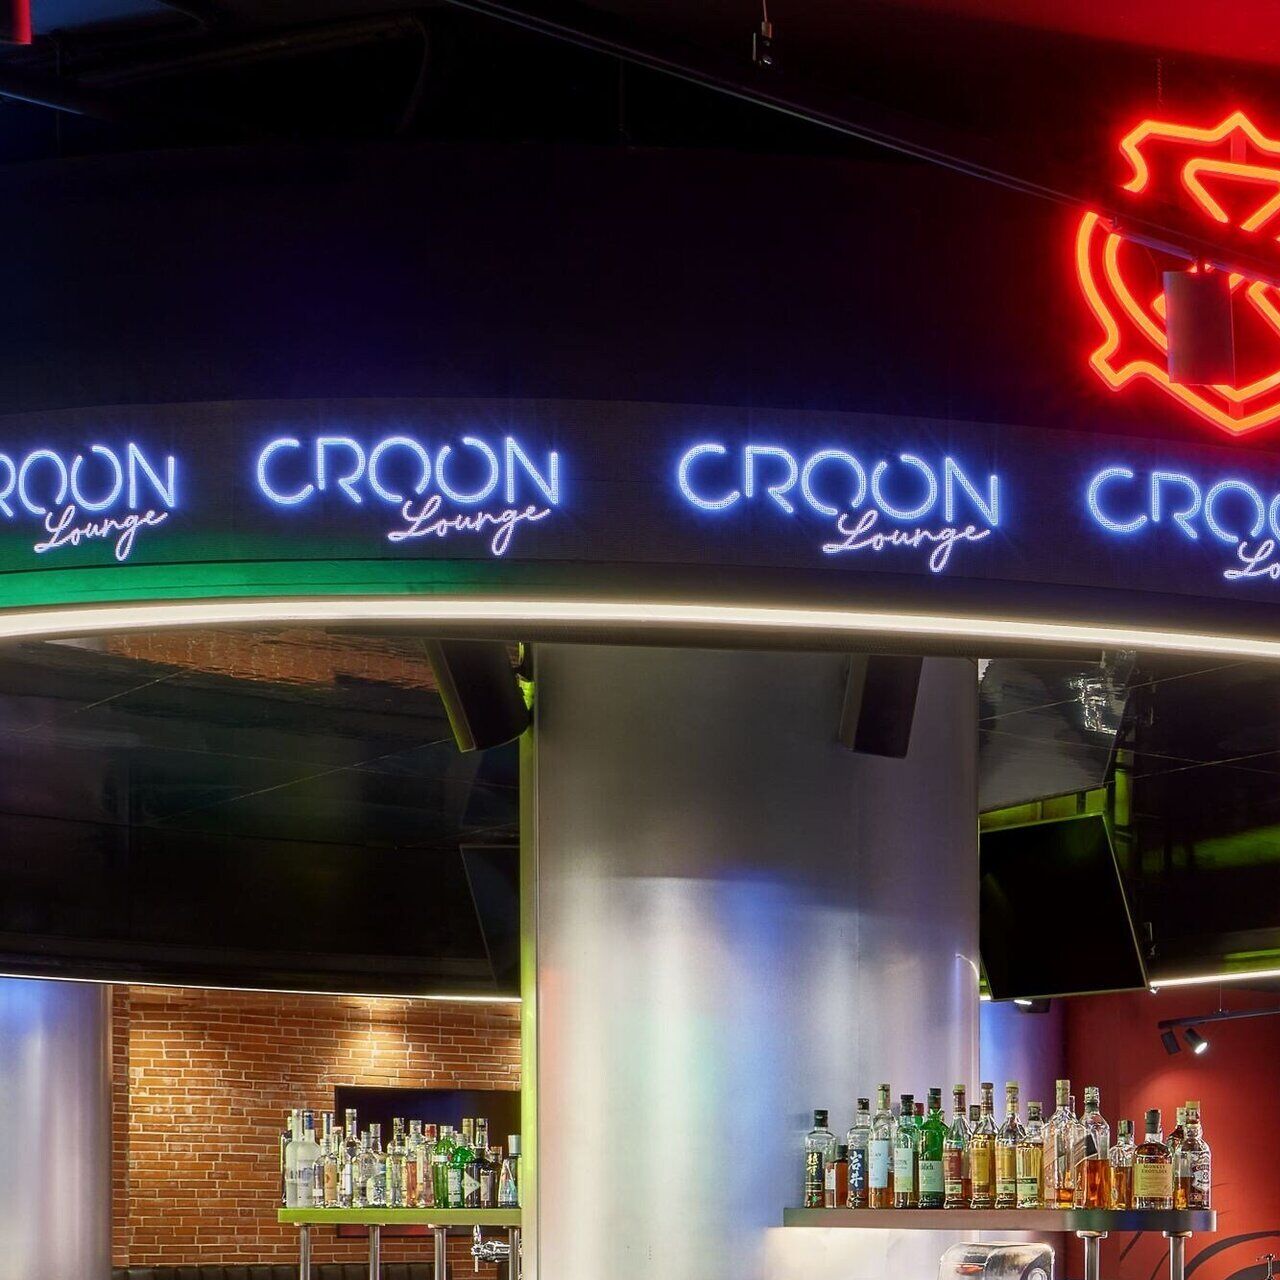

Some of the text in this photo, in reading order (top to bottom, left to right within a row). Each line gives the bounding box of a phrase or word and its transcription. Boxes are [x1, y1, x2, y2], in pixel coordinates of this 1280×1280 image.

[255, 435, 562, 507] CROON
[676, 442, 1001, 527] CROON
[33, 505, 169, 562] Lounge
[387, 494, 552, 556] Lounge
[822, 509, 991, 573] Lounge
